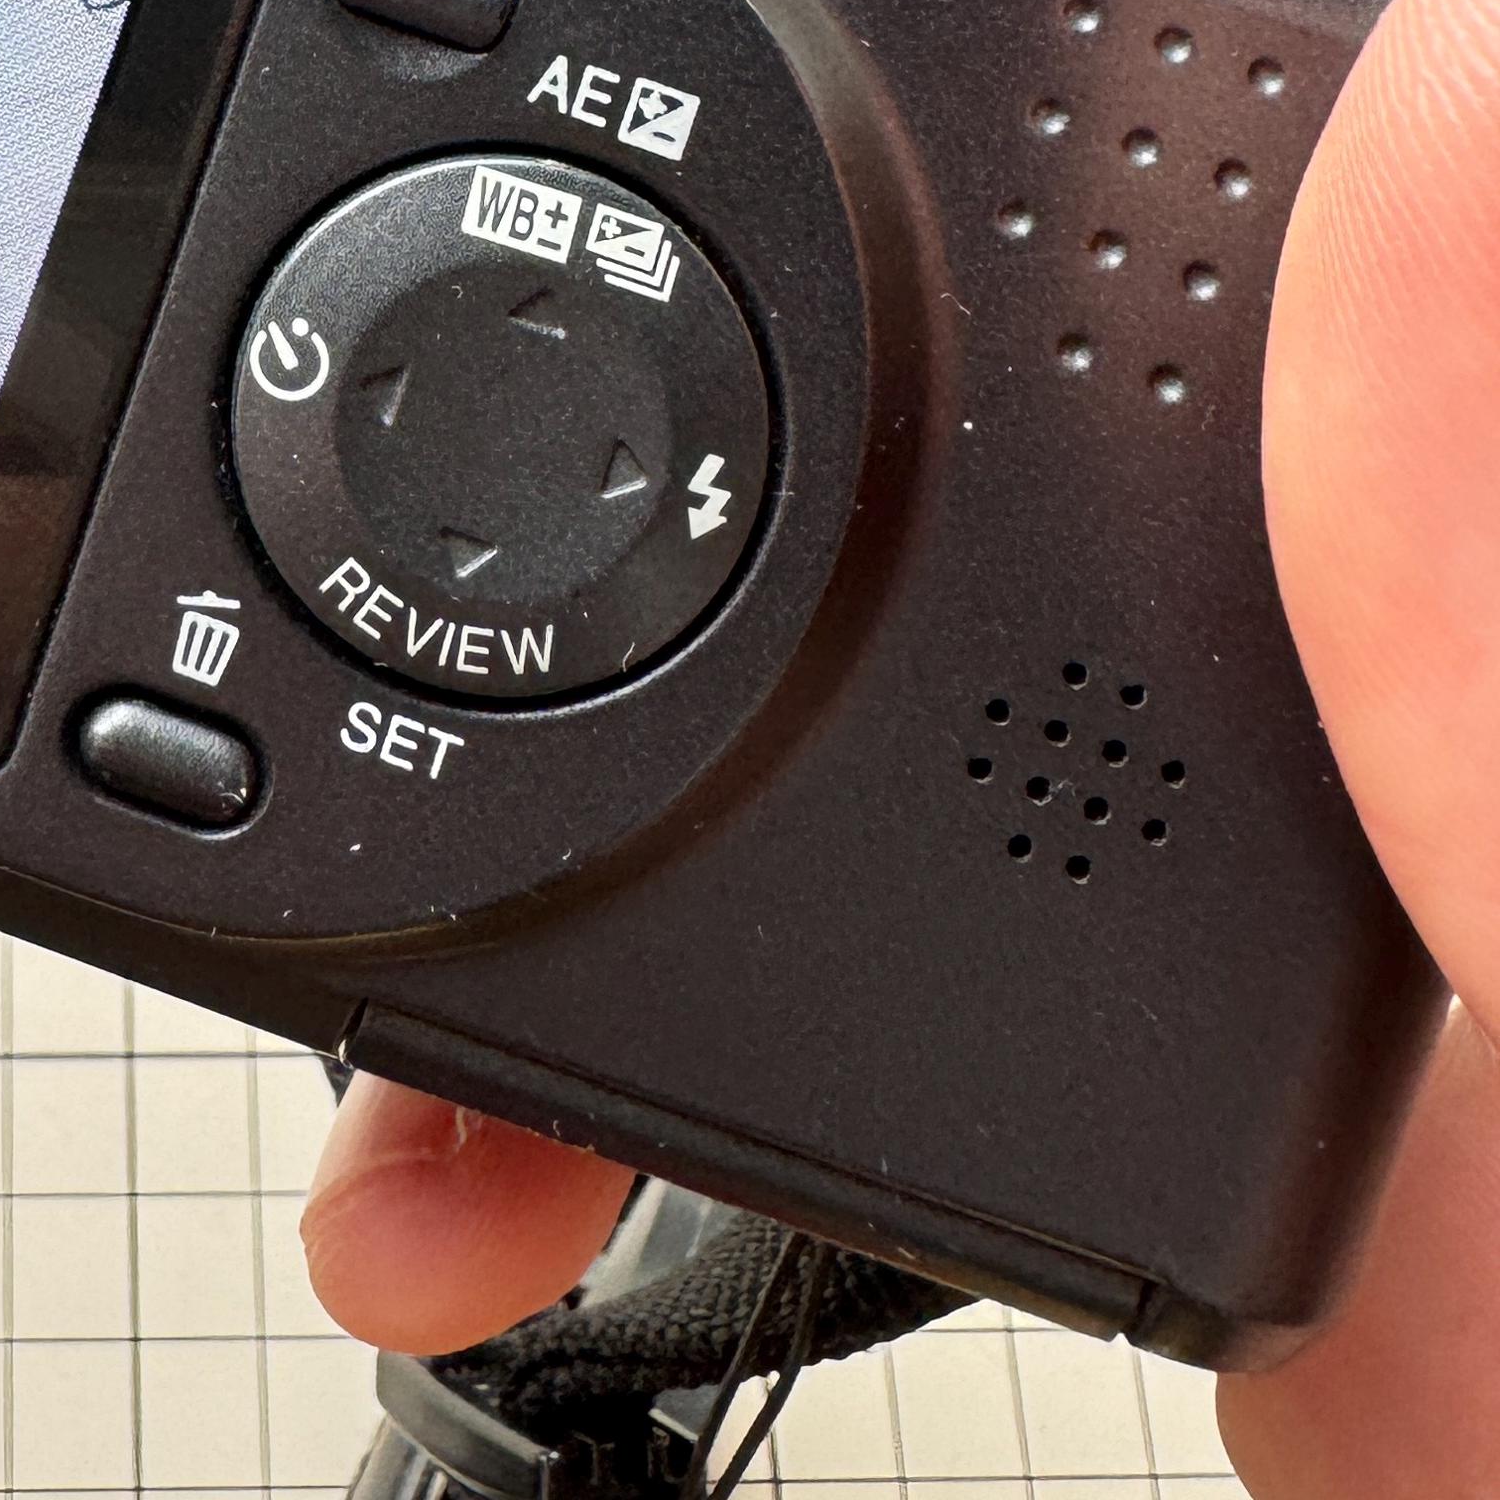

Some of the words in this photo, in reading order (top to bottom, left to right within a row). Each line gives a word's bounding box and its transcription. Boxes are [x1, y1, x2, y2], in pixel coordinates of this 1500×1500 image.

[527, 55, 621, 128] AE
[319, 556, 556, 675] REVIEW
[340, 701, 464, 780] SET
